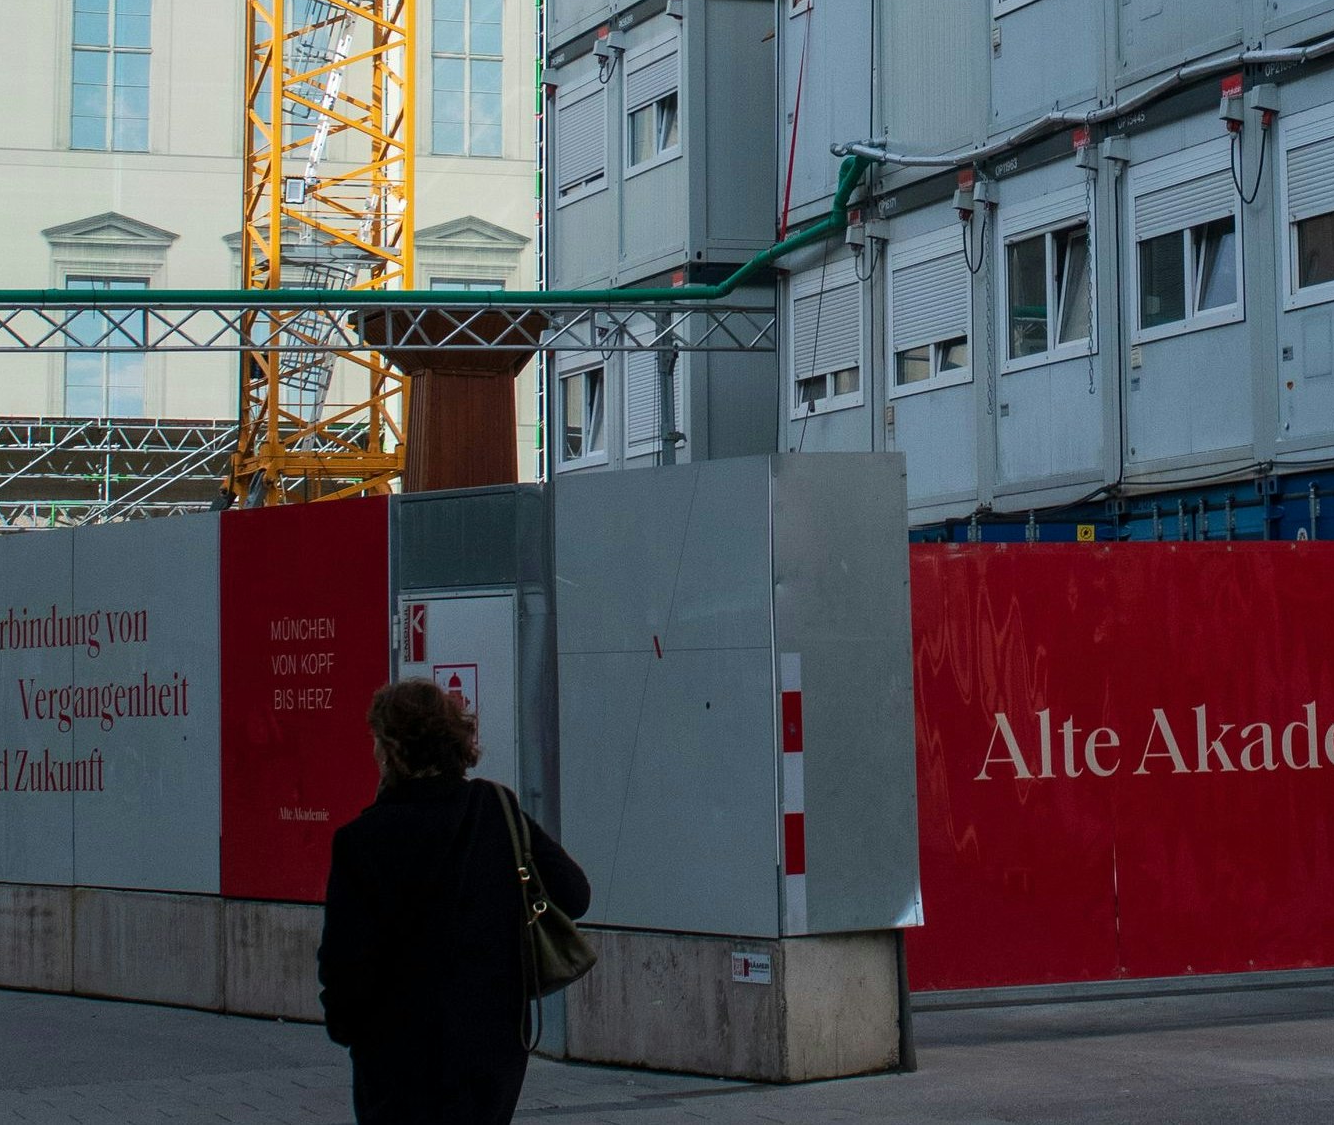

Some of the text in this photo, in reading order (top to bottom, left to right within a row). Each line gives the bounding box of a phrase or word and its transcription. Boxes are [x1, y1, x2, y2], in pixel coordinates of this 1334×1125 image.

[105, 607, 148, 644] von
[270, 617, 336, 642] MÜNCHEN
[271, 653, 334, 676] VON KOPF
[18, 671, 189, 732] Vergangenheit
[273, 688, 333, 710] BIS HERZ
[974, 709, 1121, 781] Alte
[14, 747, 104, 793] Zukunft
[278, 805, 330, 822] Alte Akademie
